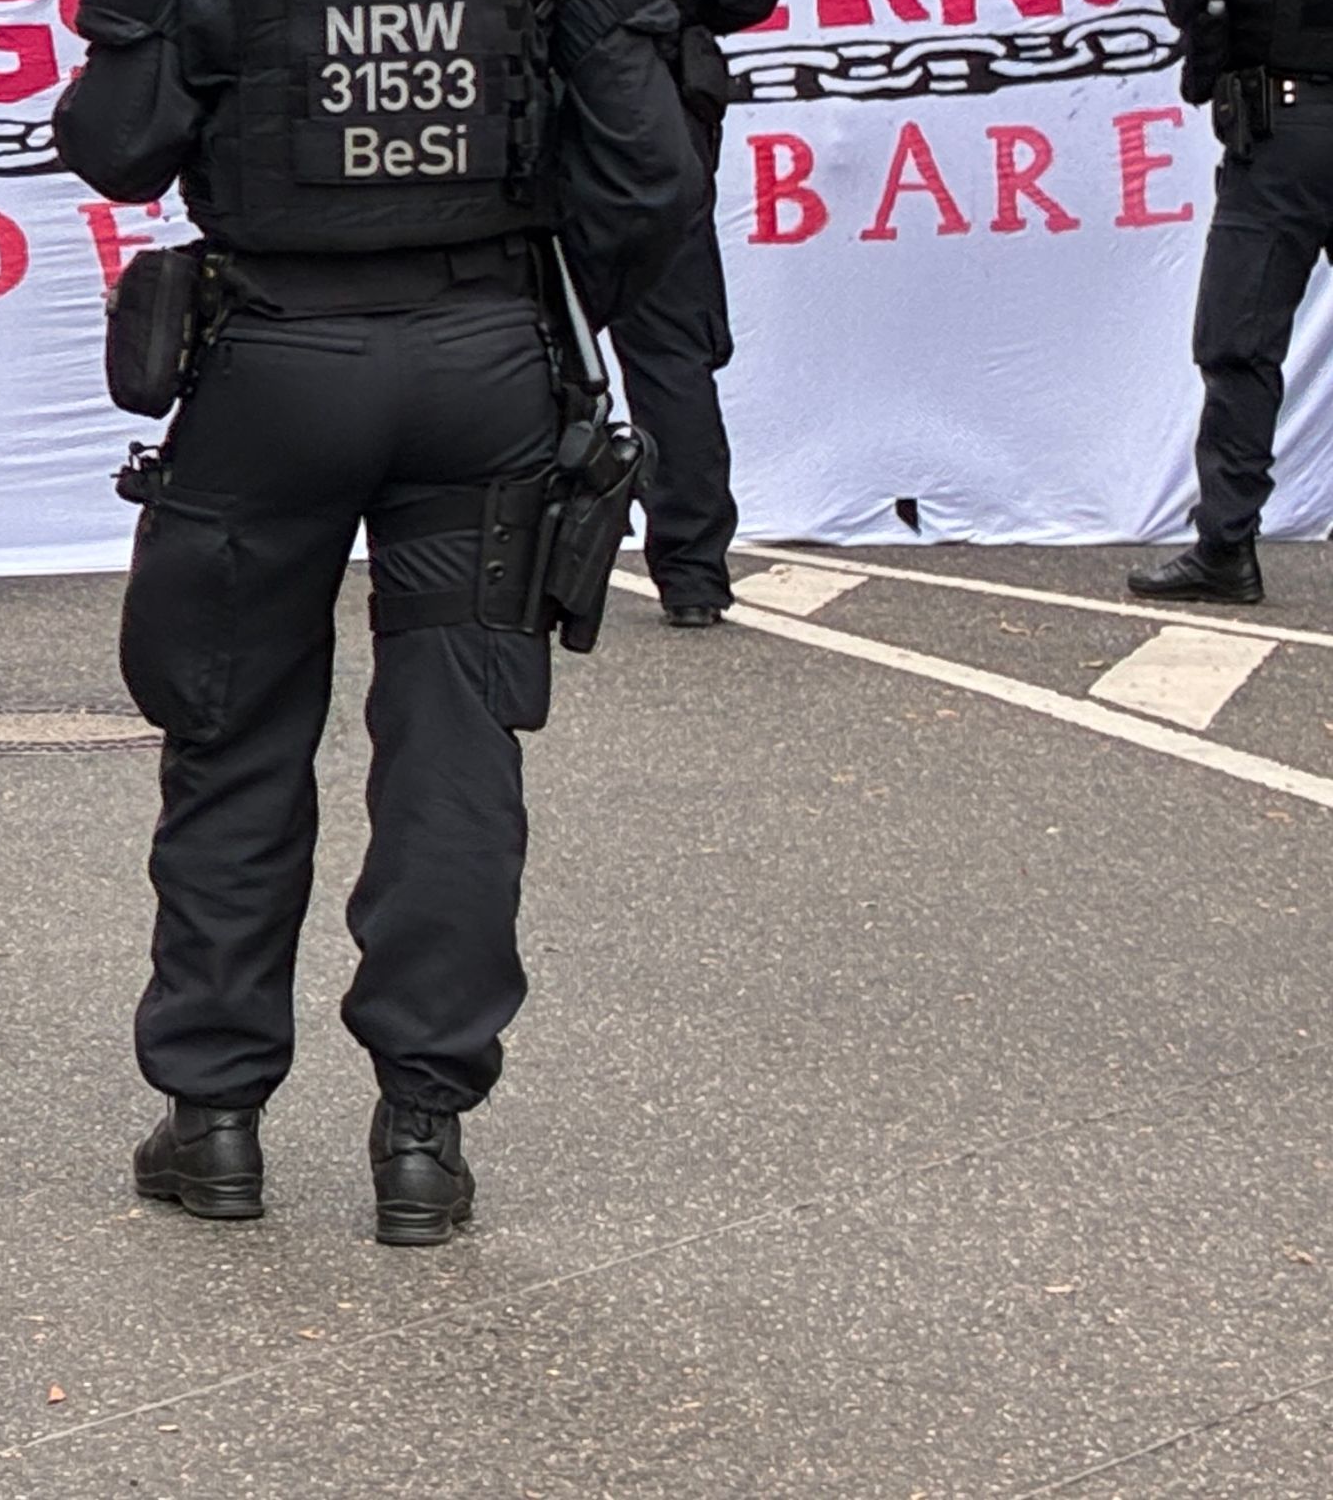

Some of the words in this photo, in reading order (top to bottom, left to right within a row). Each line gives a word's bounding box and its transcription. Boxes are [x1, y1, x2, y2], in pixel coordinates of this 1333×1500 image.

[326, 1, 465, 55] NRW
[321, 58, 477, 113] 31533
[344, 124, 468, 177] BeSi
